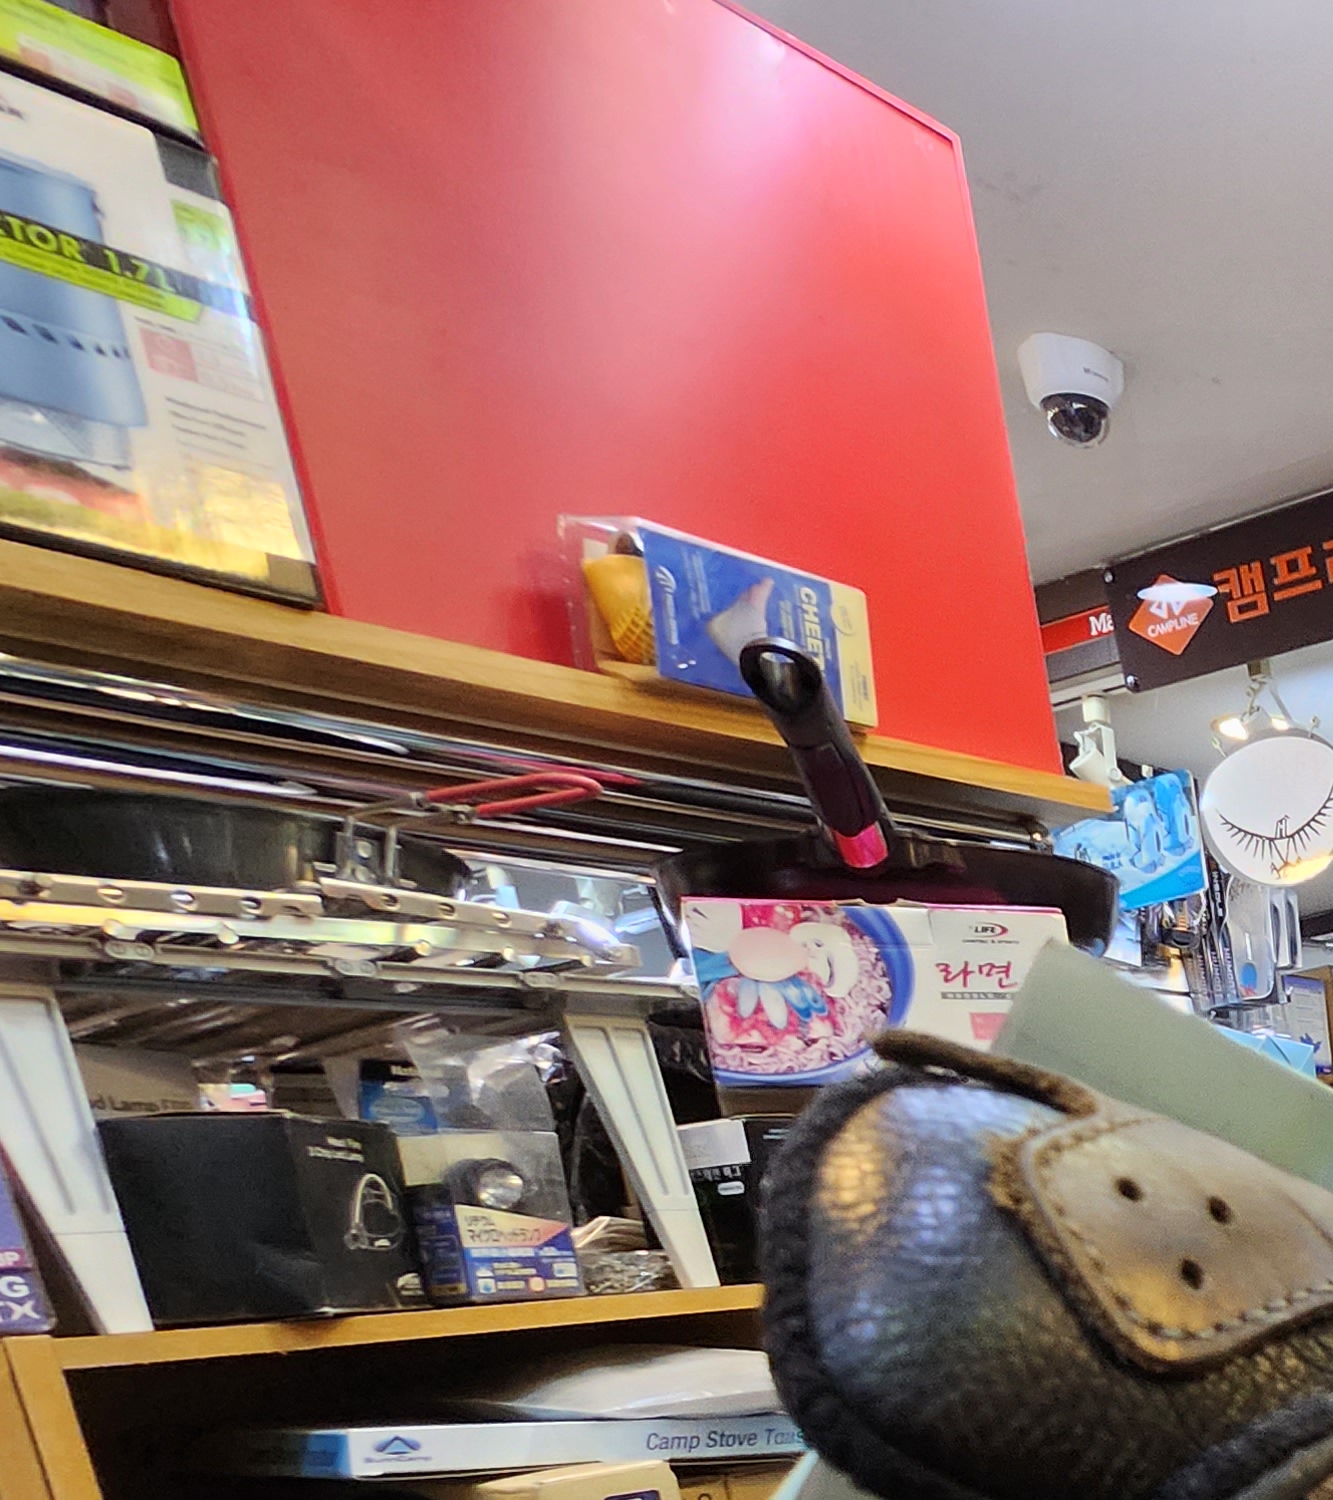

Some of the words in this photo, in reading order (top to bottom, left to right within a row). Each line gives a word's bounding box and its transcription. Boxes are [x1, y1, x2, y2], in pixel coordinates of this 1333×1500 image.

[1147, 612, 1200, 638] CAMPLINE
[934, 960, 1019, 990] 라면
[646, 1431, 701, 1453] Camp
[706, 1429, 758, 1449] Stove
